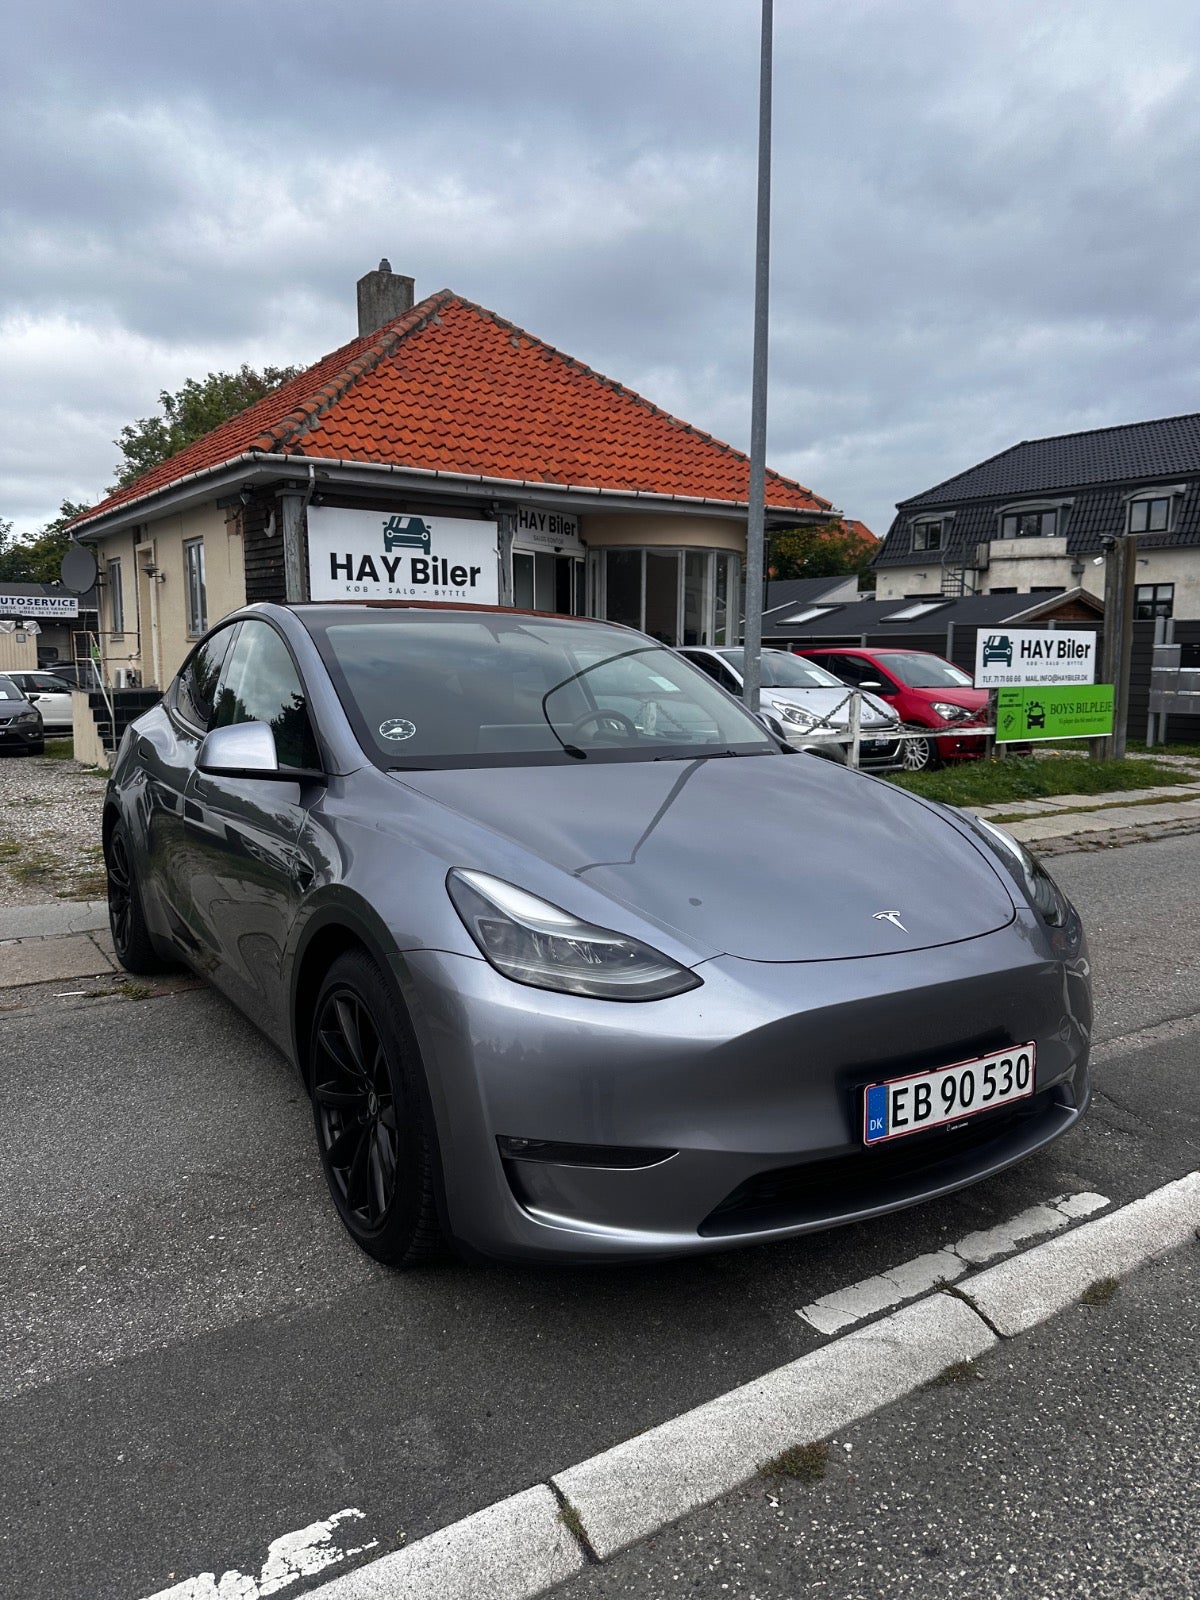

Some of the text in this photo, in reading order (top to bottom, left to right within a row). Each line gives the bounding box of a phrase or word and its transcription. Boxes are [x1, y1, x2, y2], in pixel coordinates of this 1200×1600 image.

[519, 510, 576, 536] HAY Biler
[330, 552, 481, 586] HAY Biler
[346, 585, 467, 597] KØB SALG BYTTE
[0, 597, 76, 607] UTOSERVICE
[1020, 638, 1091, 659] HAY Biler
[1050, 701, 1113, 715] BOYS BILPLEJE
[892, 1053, 1030, 1128] EB 90 530
[870, 1117, 883, 1131] DK
